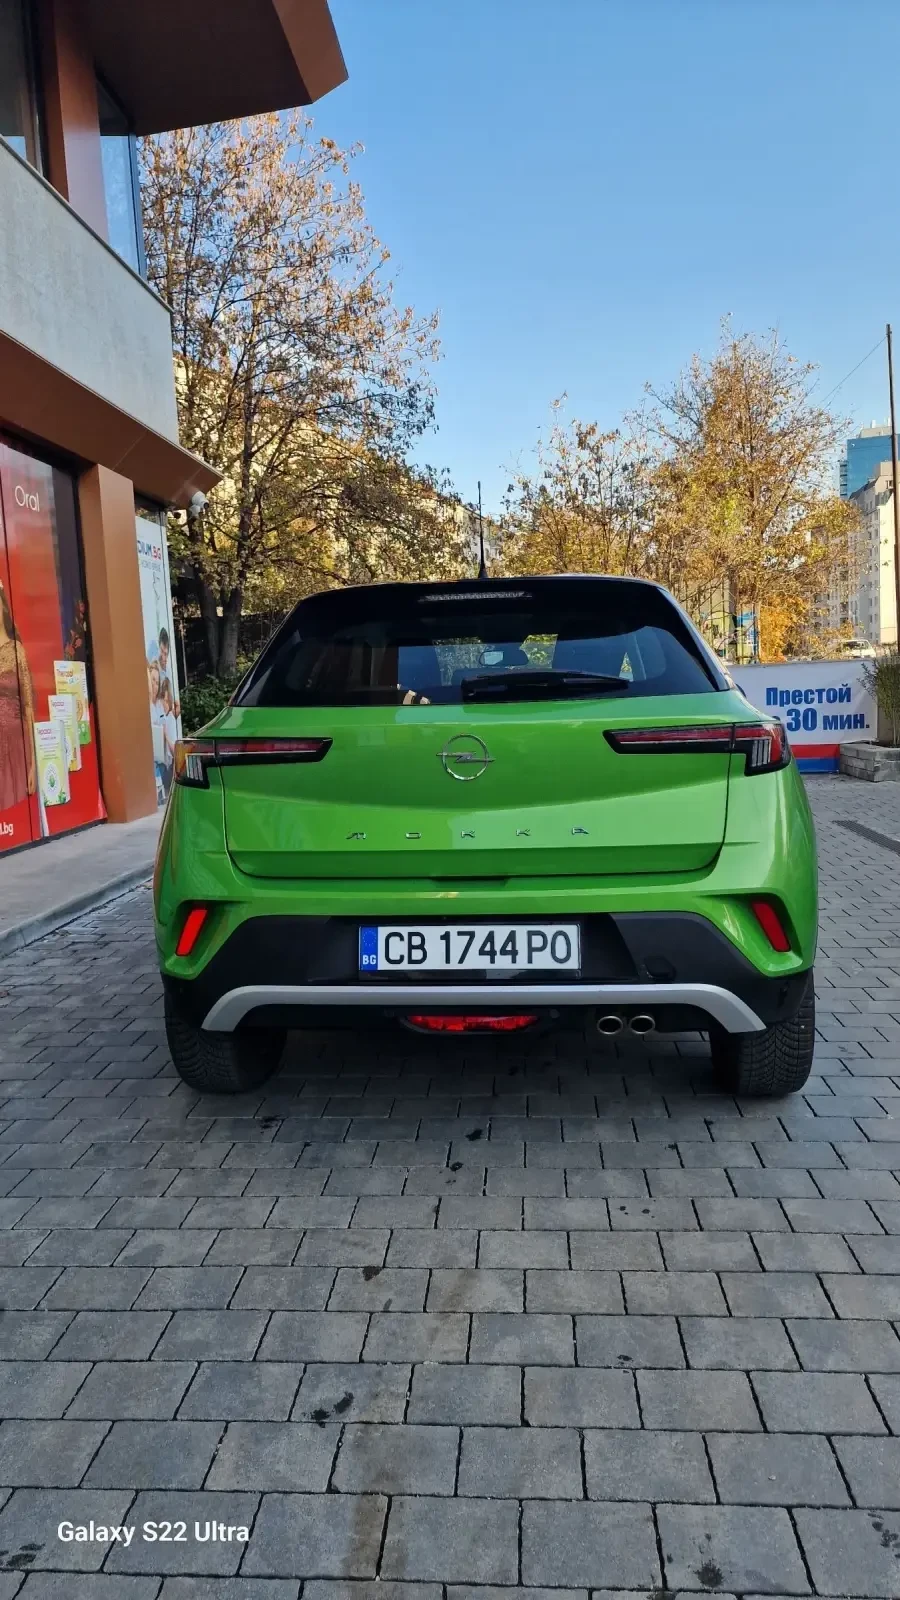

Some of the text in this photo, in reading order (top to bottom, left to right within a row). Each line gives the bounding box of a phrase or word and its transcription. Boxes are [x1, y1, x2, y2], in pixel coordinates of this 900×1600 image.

[15, 485, 40, 512] Oral
[766, 684, 852, 707] Престой
[787, 708, 870, 732] 30 мин.
[346, 827, 589, 840] MOKKA
[384, 931, 428, 965] CB
[440, 930, 518, 964] 1744
[362, 955, 377, 965] BG
